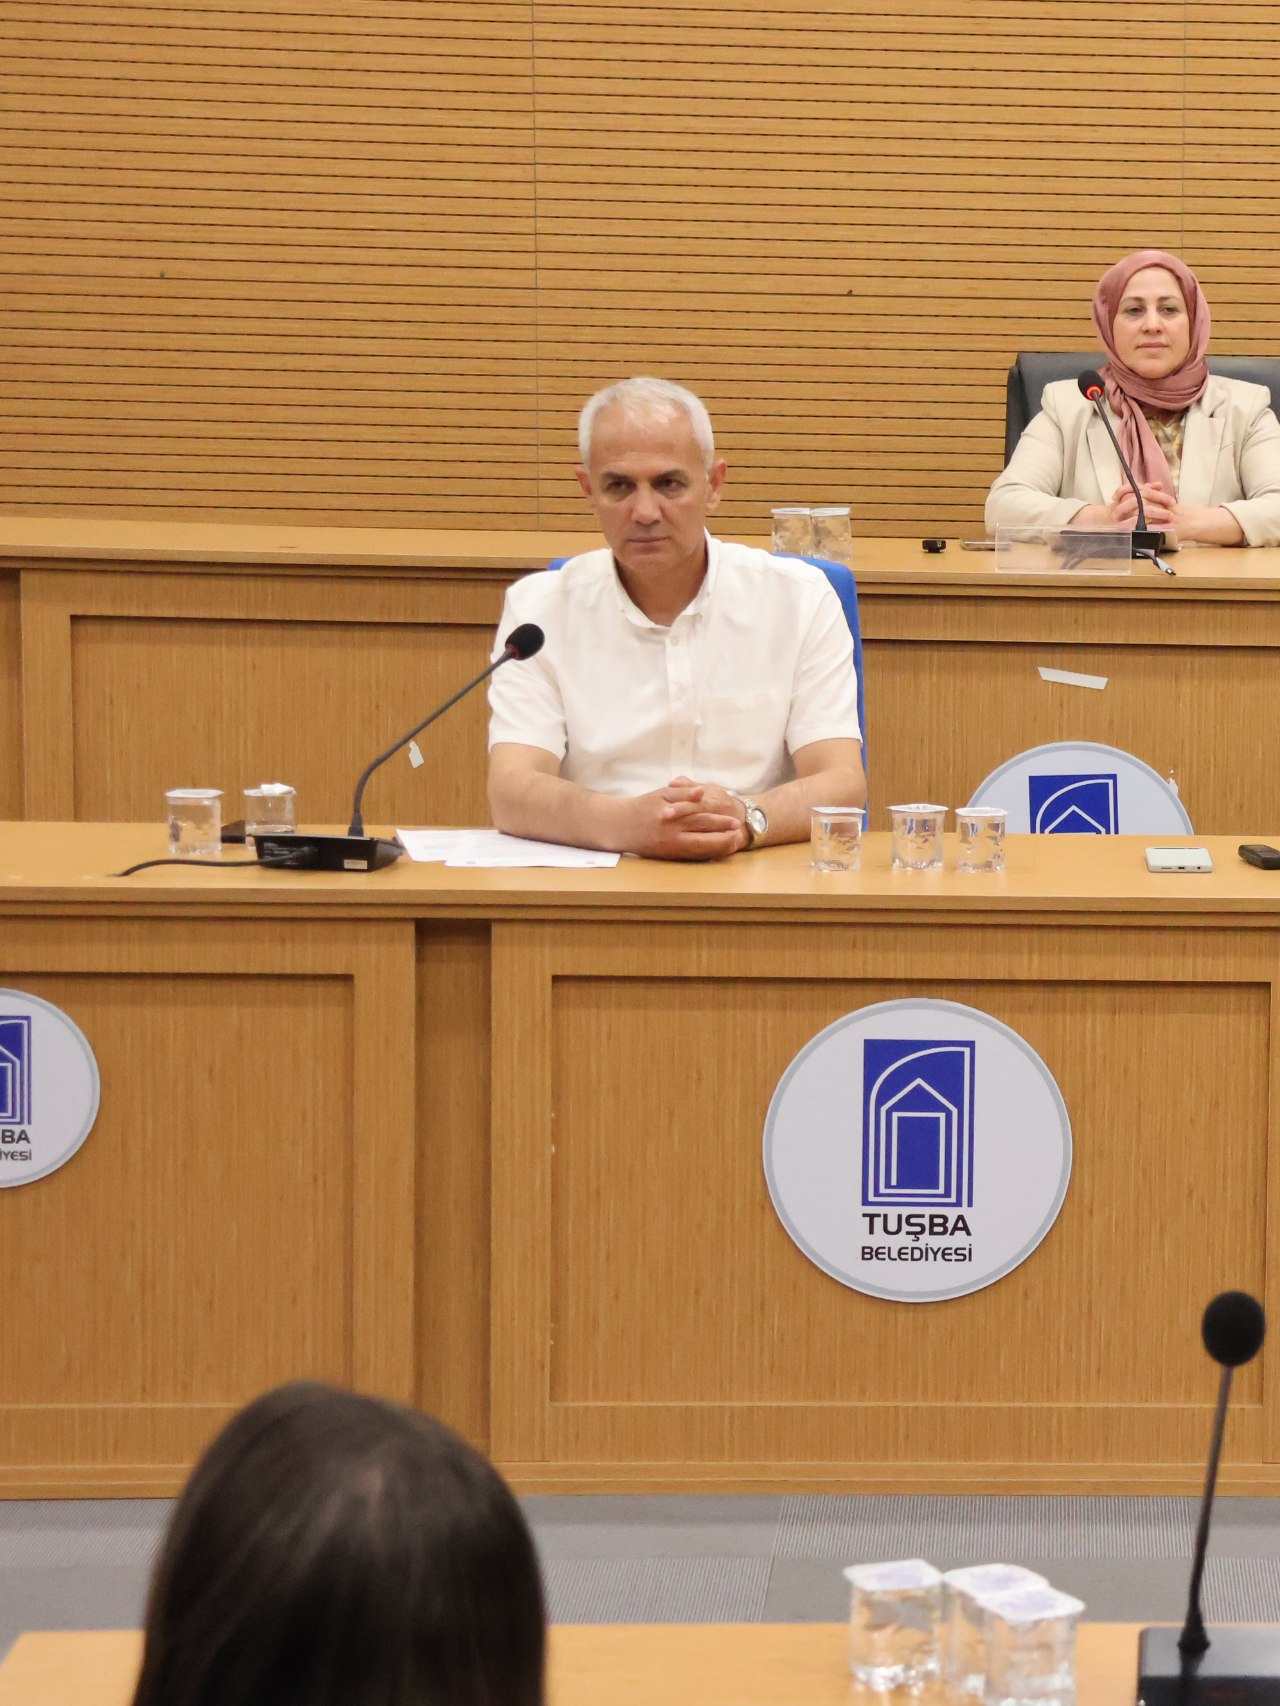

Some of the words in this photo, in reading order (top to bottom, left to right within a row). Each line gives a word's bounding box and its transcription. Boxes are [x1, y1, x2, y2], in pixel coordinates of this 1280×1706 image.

[0, 1128, 31, 1144] BA
[862, 1213, 972, 1242] TUŞBA
[861, 1243, 972, 1262] BELEDİYESİ
